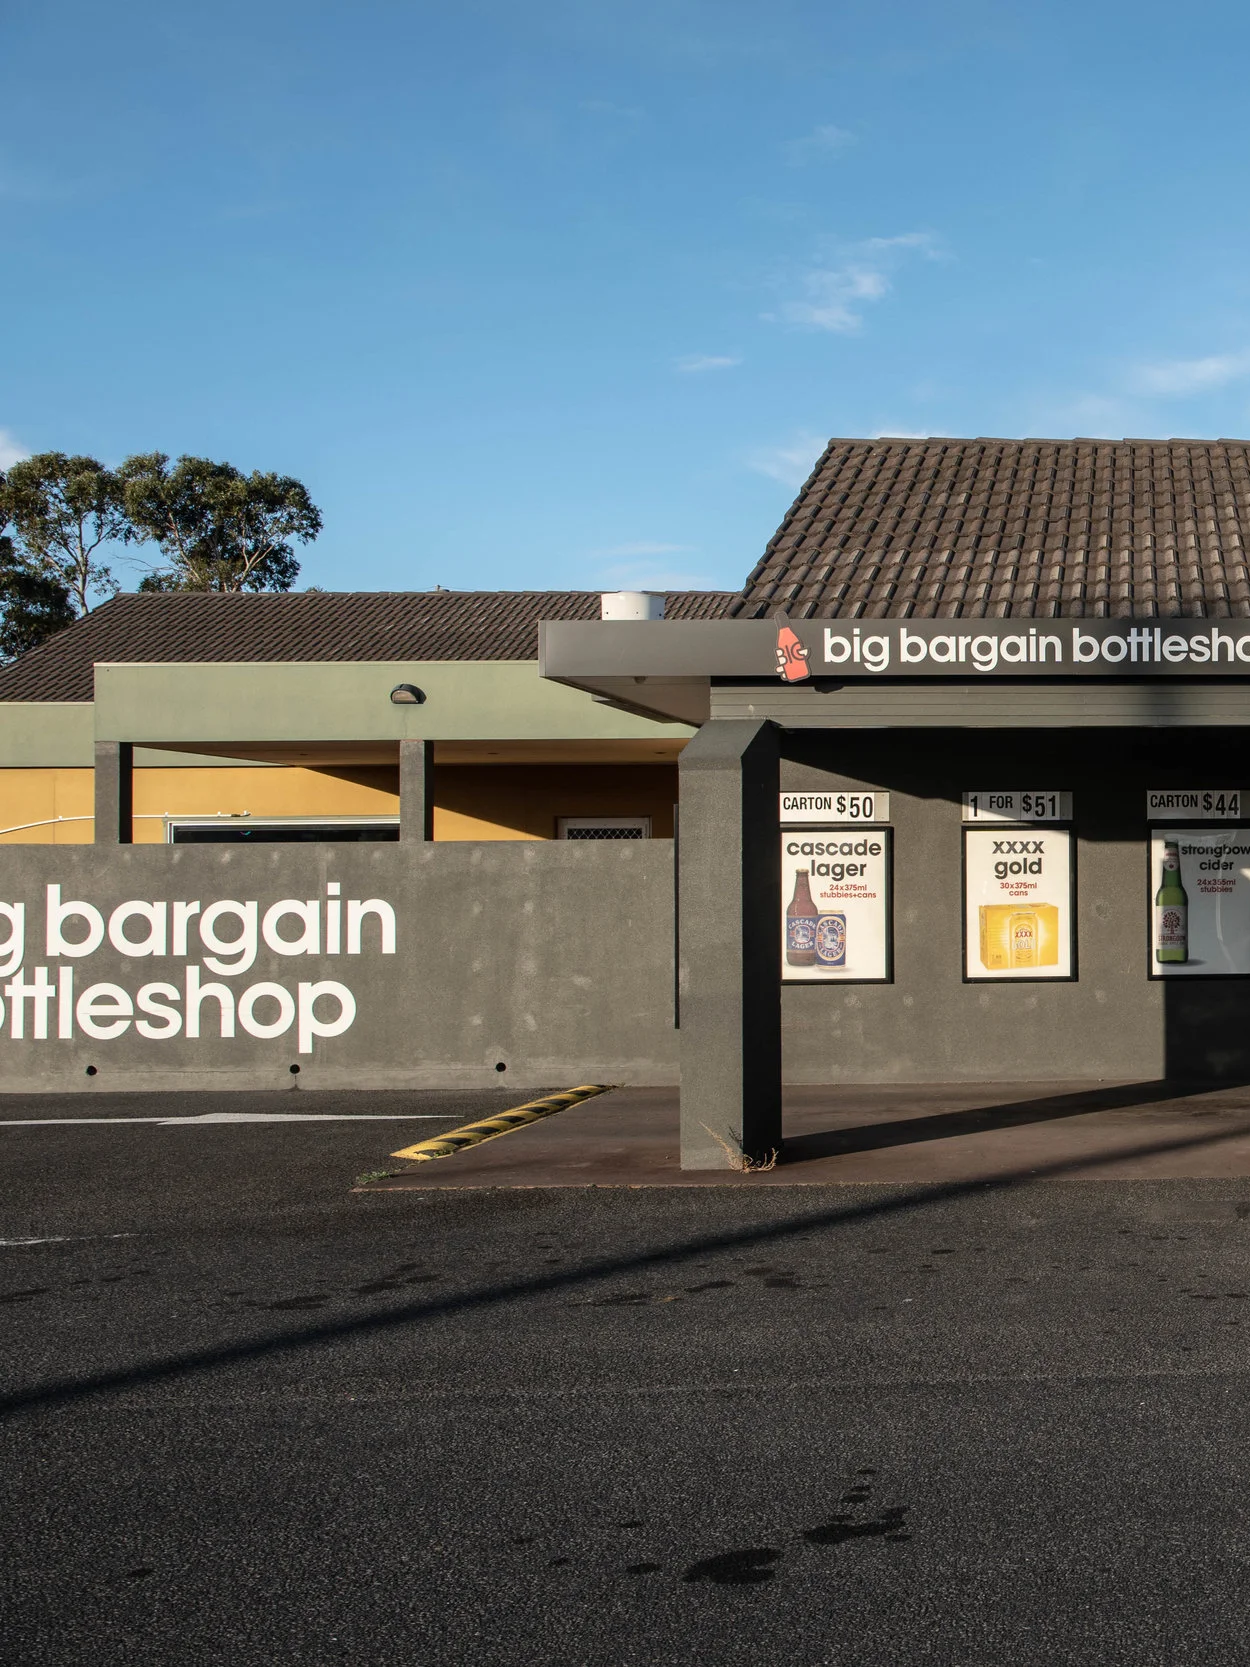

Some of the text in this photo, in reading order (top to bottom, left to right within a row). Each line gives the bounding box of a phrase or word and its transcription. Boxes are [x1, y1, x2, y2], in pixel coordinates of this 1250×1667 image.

[824, 627, 890, 672] big
[900, 627, 1063, 672] bargain
[783, 794, 873, 818] CARTON $50
[970, 794, 1056, 817] 1 FOR $51
[1150, 792, 1240, 815] CARTON $44
[787, 839, 881, 856] cascade
[1181, 844, 1250, 858] strongbow
[811, 860, 867, 881] lager
[994, 857, 1042, 880] gold
[1200, 860, 1234, 871] cider
[46, 882, 396, 976] bargain
[0, 965, 356, 1053] ttleshop
